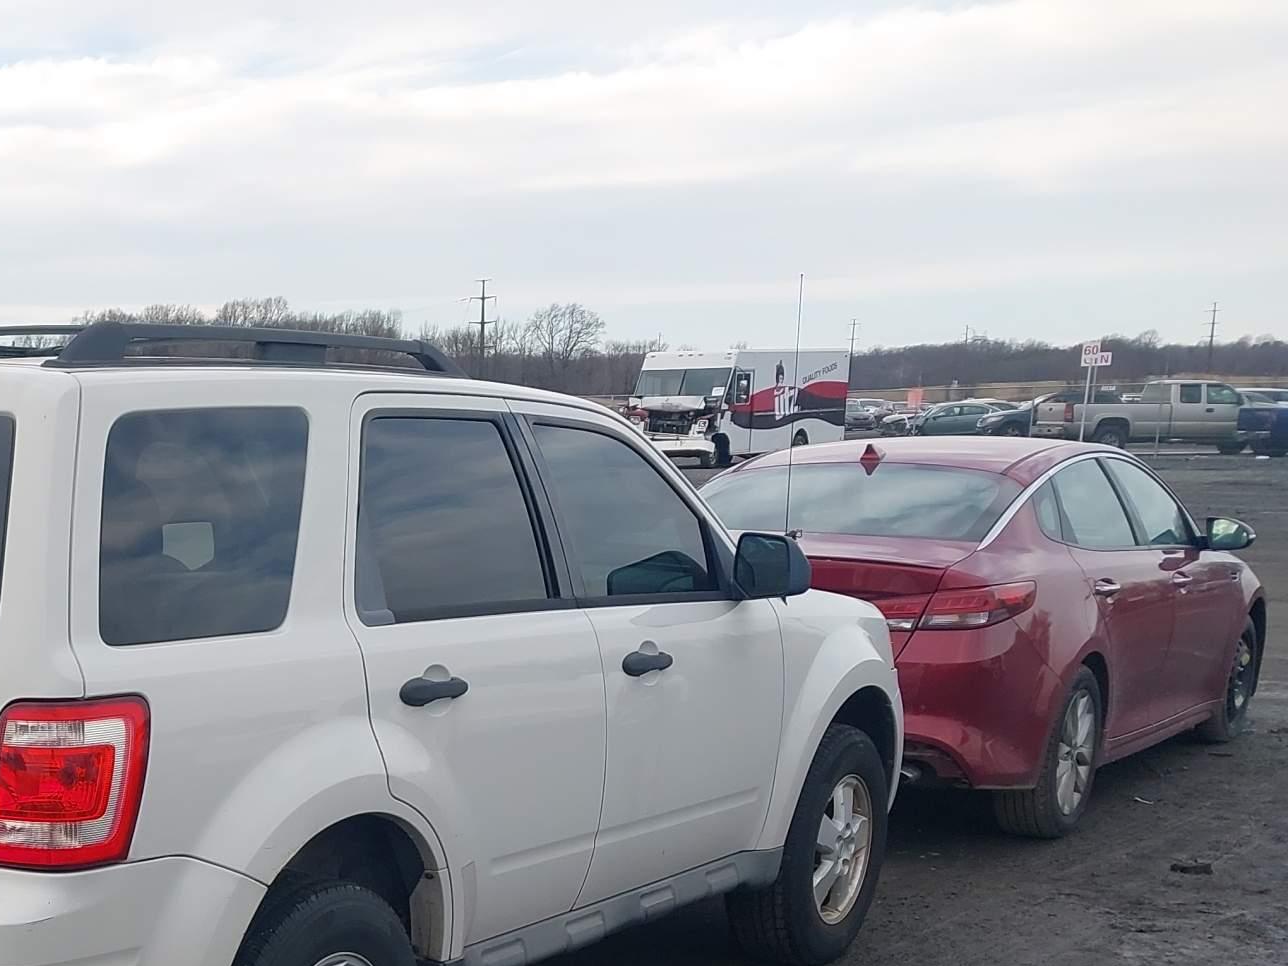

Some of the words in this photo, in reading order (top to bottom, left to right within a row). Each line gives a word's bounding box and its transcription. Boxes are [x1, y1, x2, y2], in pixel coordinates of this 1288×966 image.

[1084, 345, 1099, 355] 60
[1100, 354, 1109, 363] N
[802, 369, 821, 384] QUALITY
[822, 362, 838, 375] FOODS
